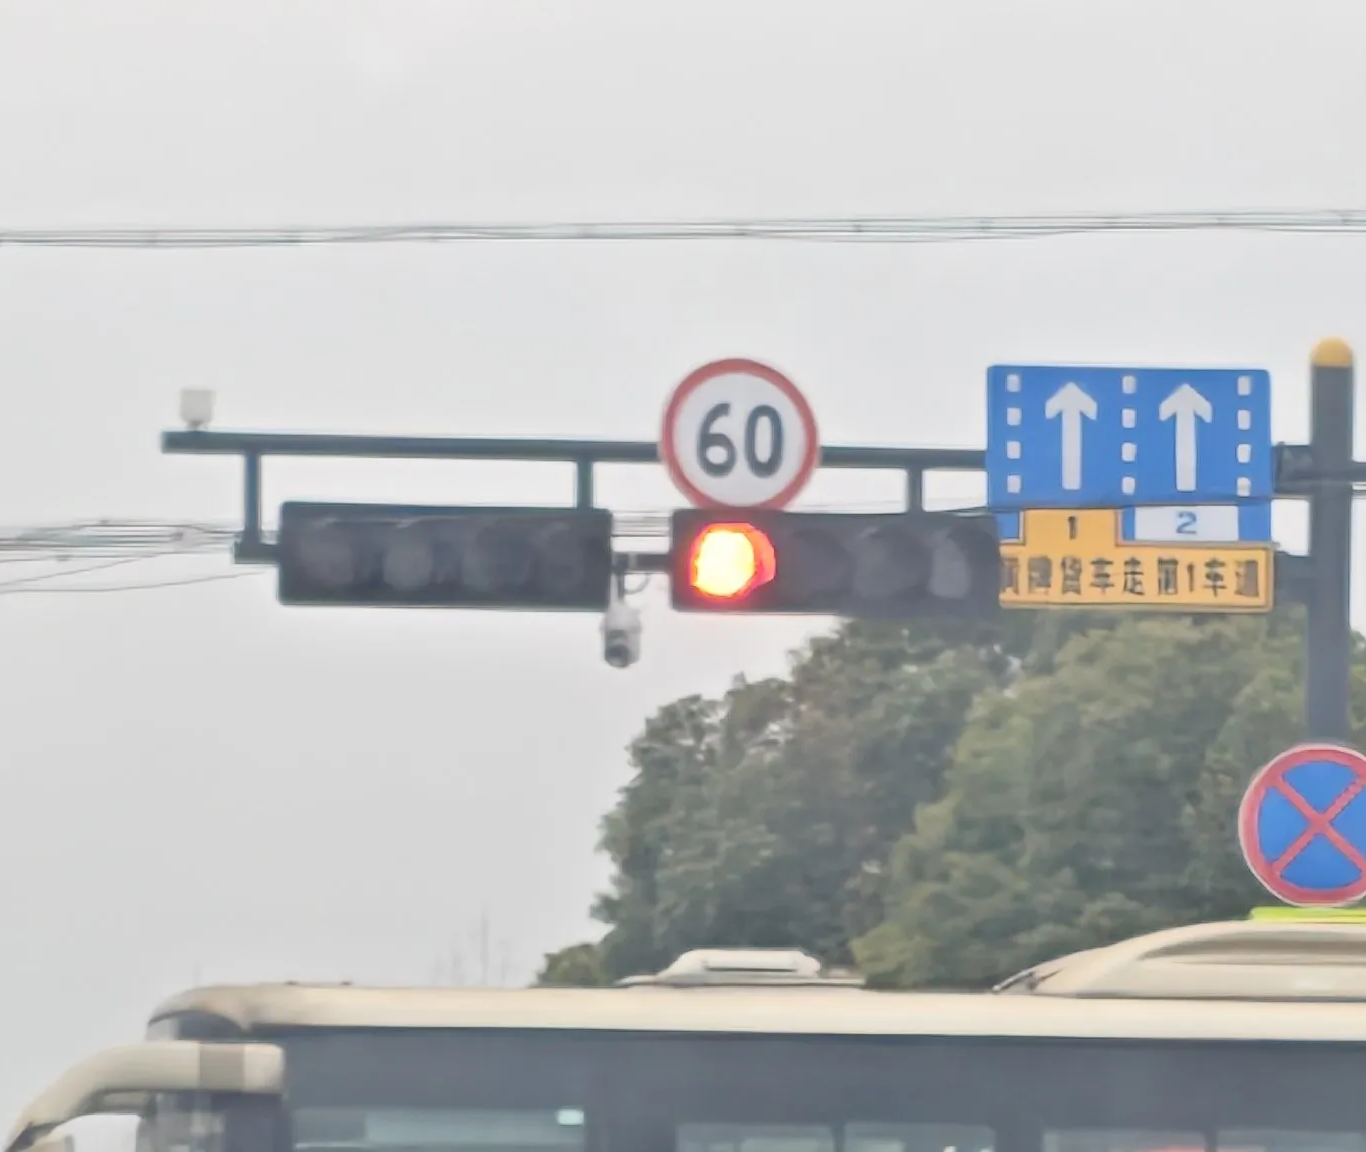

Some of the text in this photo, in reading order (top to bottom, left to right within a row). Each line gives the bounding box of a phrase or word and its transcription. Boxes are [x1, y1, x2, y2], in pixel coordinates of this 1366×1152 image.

[695, 401, 784, 479] 60
[1066, 514, 1078, 541] 1
[1175, 510, 1199, 536] 2
